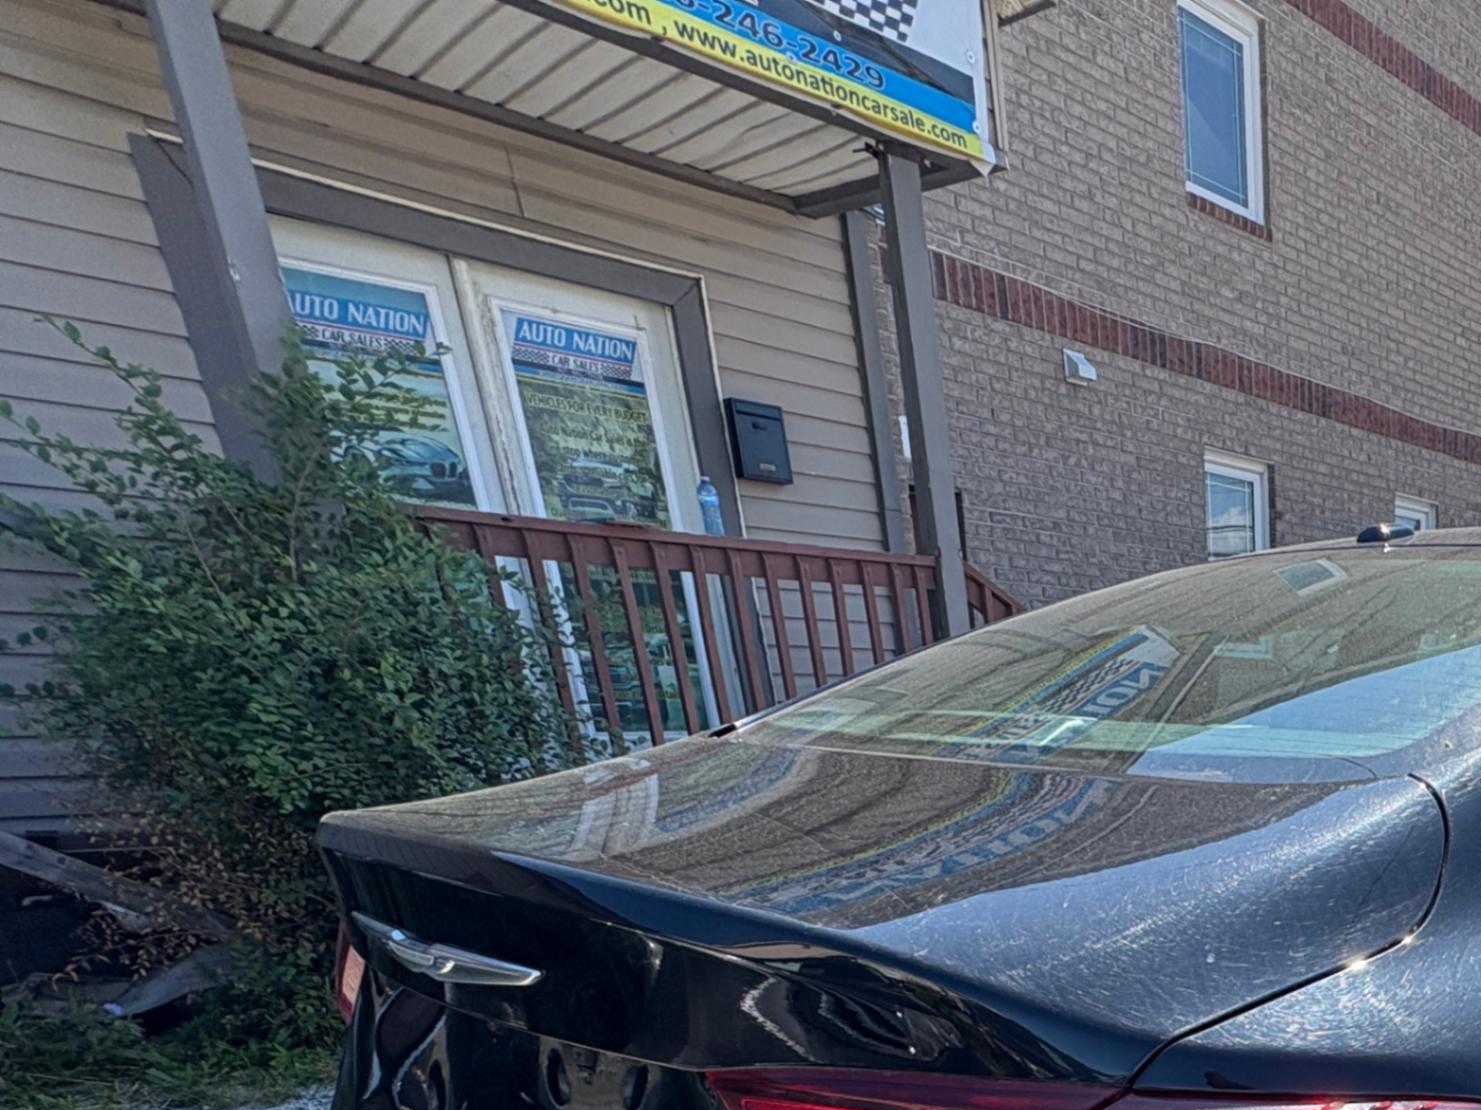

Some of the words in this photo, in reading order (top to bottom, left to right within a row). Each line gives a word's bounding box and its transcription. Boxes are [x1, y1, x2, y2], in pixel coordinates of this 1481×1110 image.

[674, 19, 968, 149] www.autonationcarsale.com
[348, 301, 424, 335] NATION
[322, 327, 347, 344] CAR
[349, 332, 383, 349] SALES
[520, 320, 566, 347] AUTO
[572, 331, 633, 360] NATION
